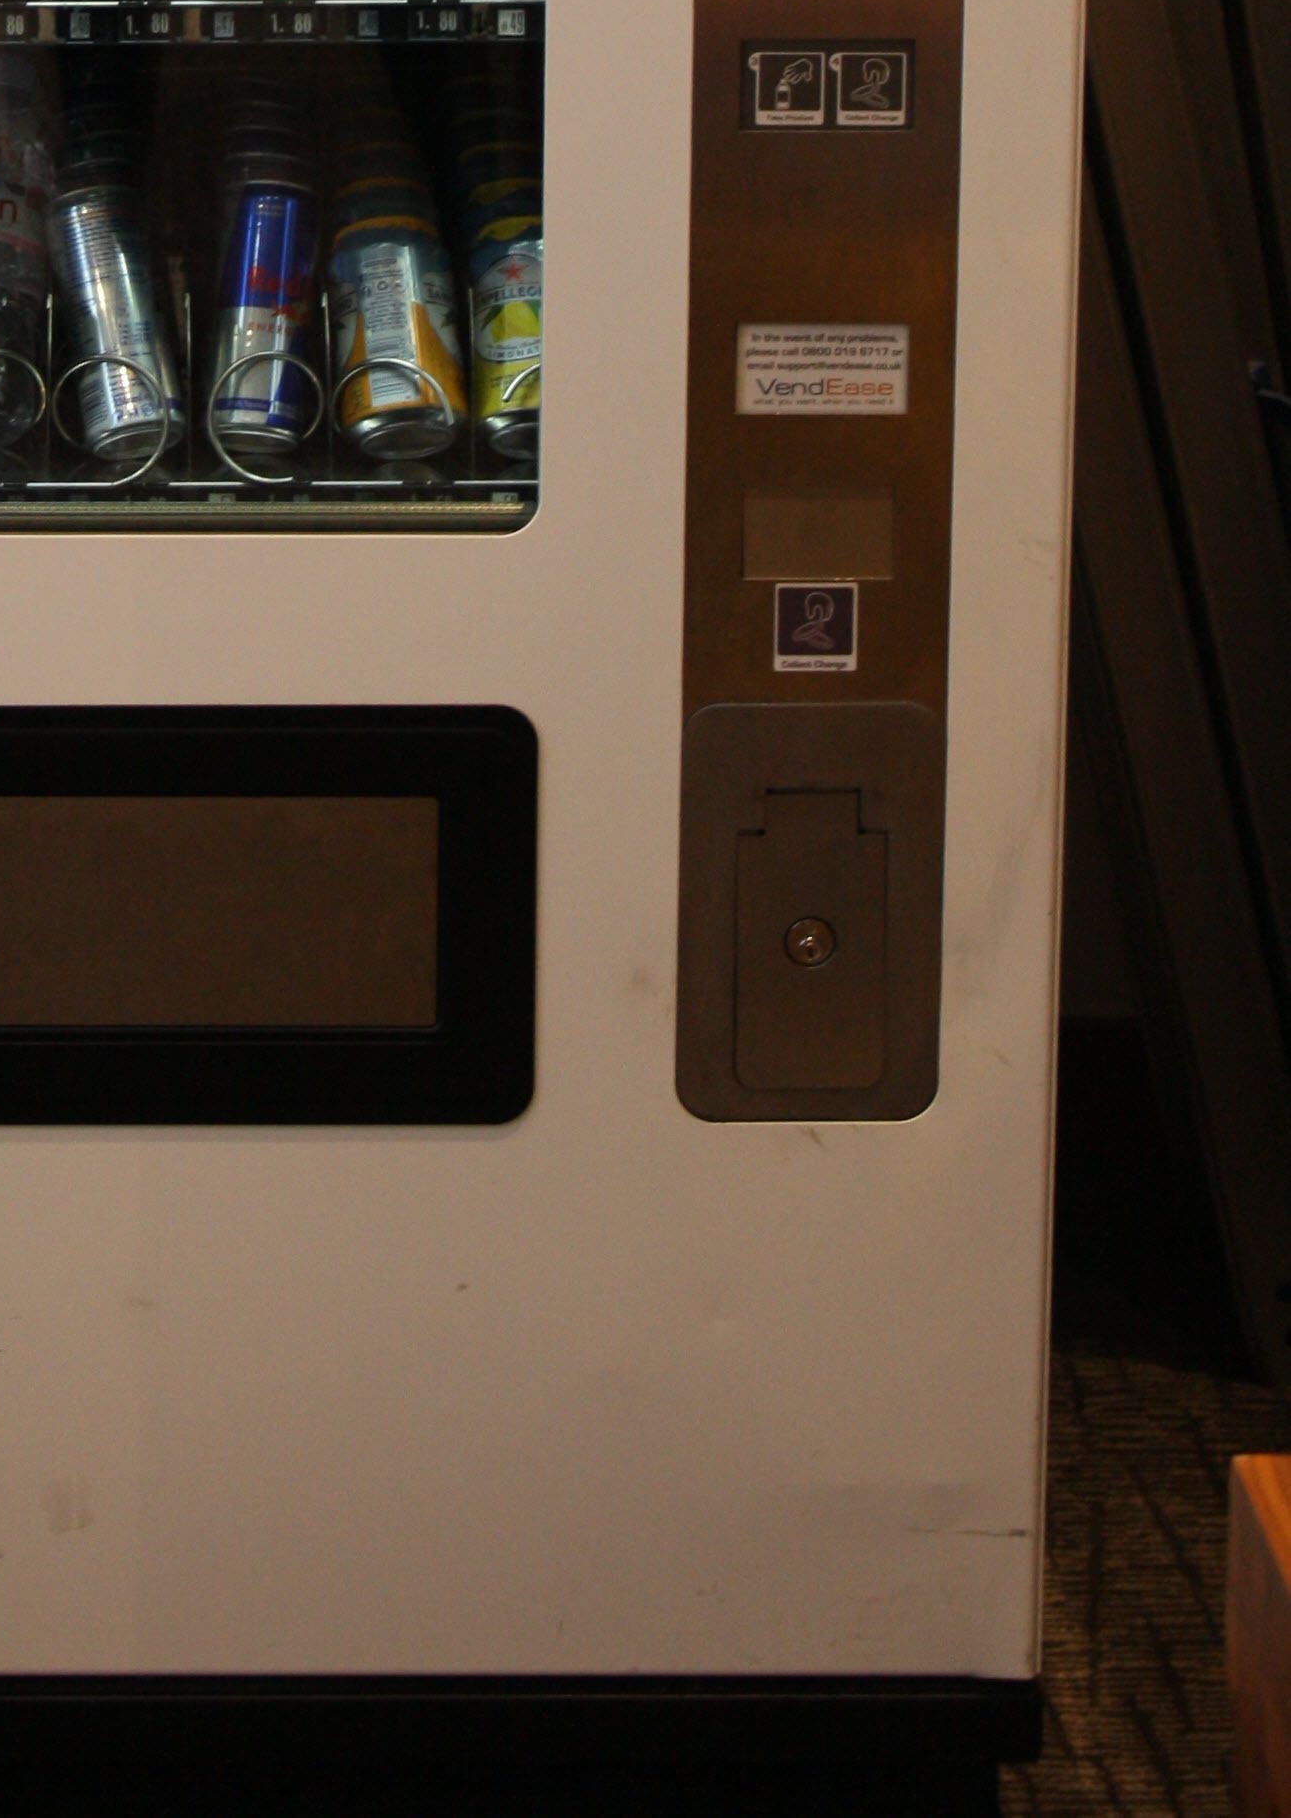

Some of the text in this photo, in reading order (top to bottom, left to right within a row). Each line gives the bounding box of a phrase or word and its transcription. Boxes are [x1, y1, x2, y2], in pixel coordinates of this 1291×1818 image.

[764, 333, 780, 342] the
[783, 334, 811, 342] event
[814, 333, 825, 342] of
[827, 335, 844, 344] any
[746, 347, 778, 357] please
[782, 347, 799, 356] call
[801, 347, 831, 357] 0800
[834, 347, 857, 357] 019
[859, 347, 889, 357] 6717
[747, 361, 775, 370] email
[756, 378, 894, 396] VendEase
